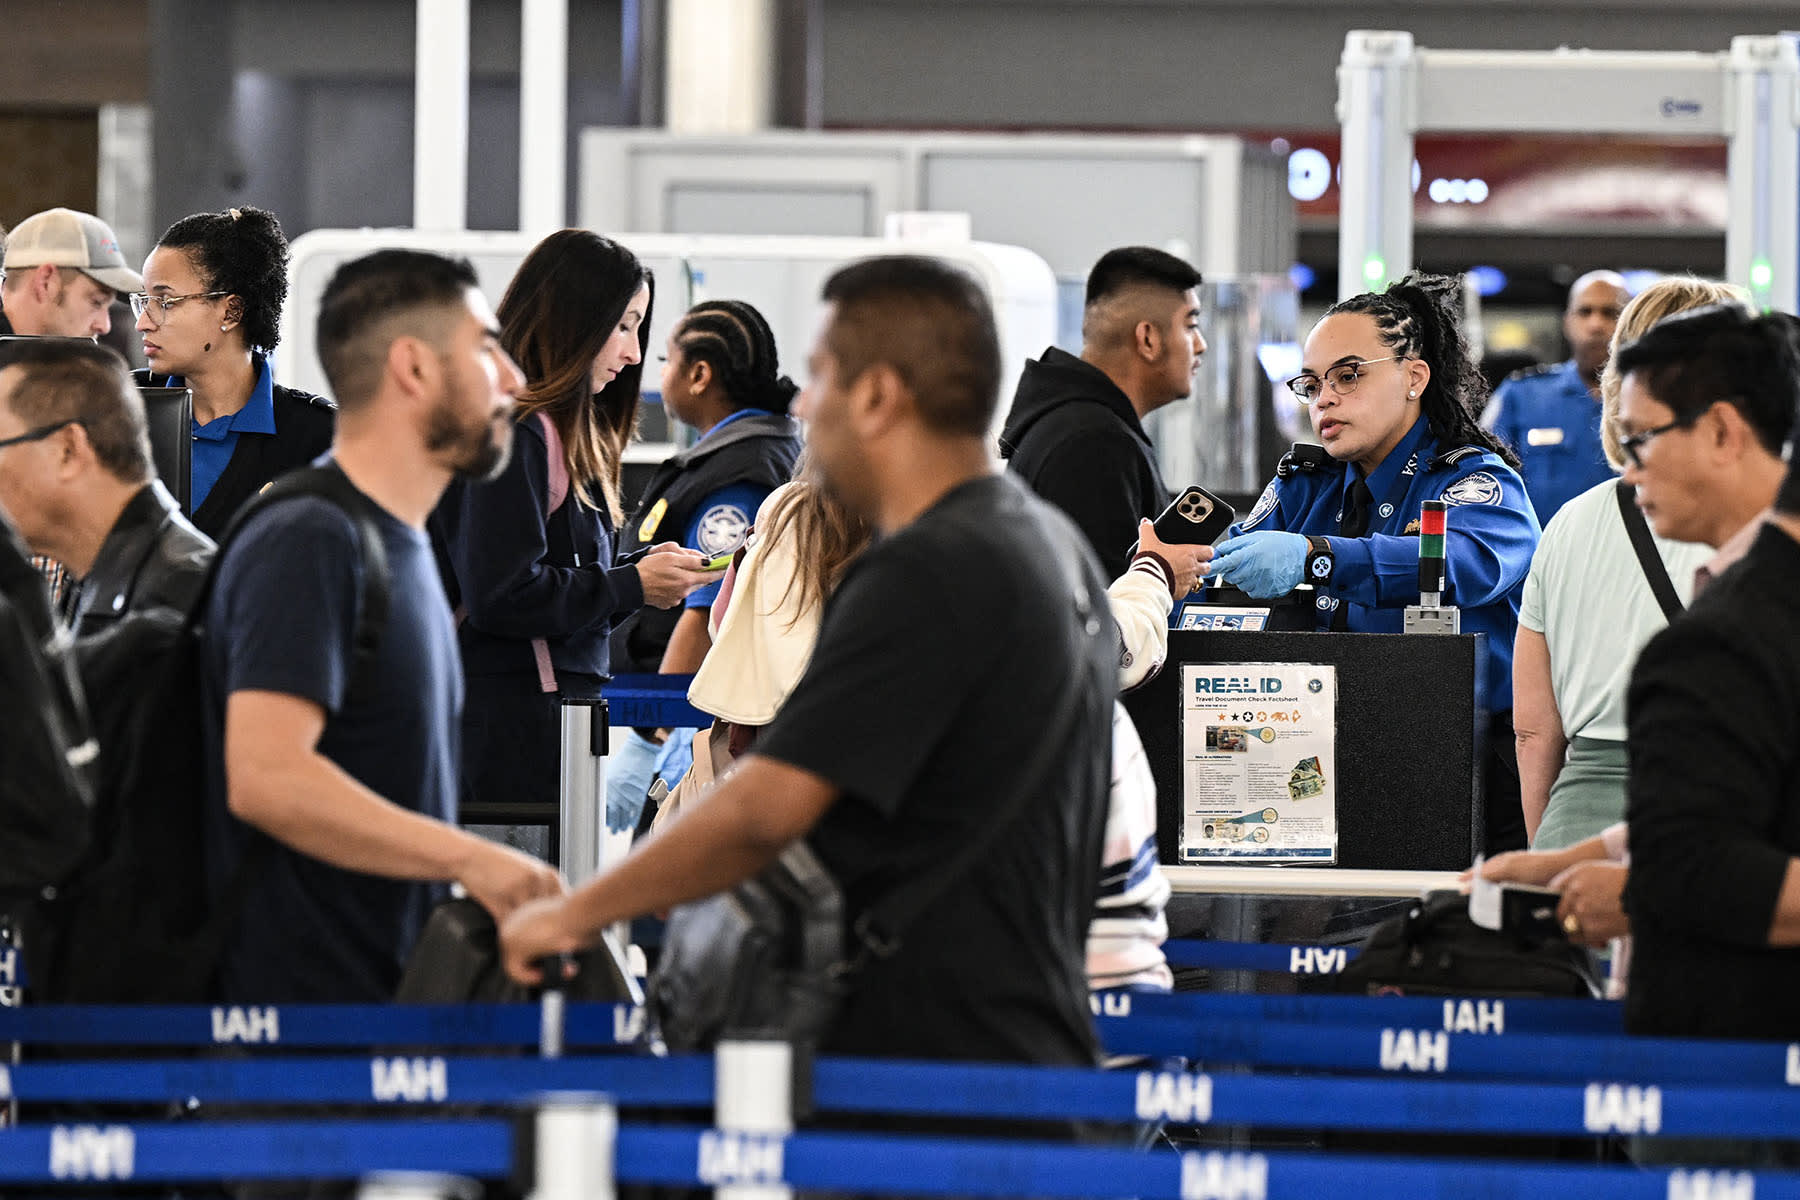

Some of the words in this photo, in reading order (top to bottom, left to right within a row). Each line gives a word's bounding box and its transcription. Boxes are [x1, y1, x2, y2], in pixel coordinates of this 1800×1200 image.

[1195, 677, 1257, 693] REAL
[1260, 677, 1282, 693] ID
[211, 1007, 279, 1042] IAH
[1443, 999, 1504, 1035] IAH
[1380, 1028, 1449, 1072] IAH
[370, 1057, 448, 1101] IAH
[1135, 1071, 1213, 1123] IAH
[1584, 1083, 1662, 1134] IAH
[698, 1131, 784, 1183] IAH
[1180, 1151, 1268, 1200] IAH
